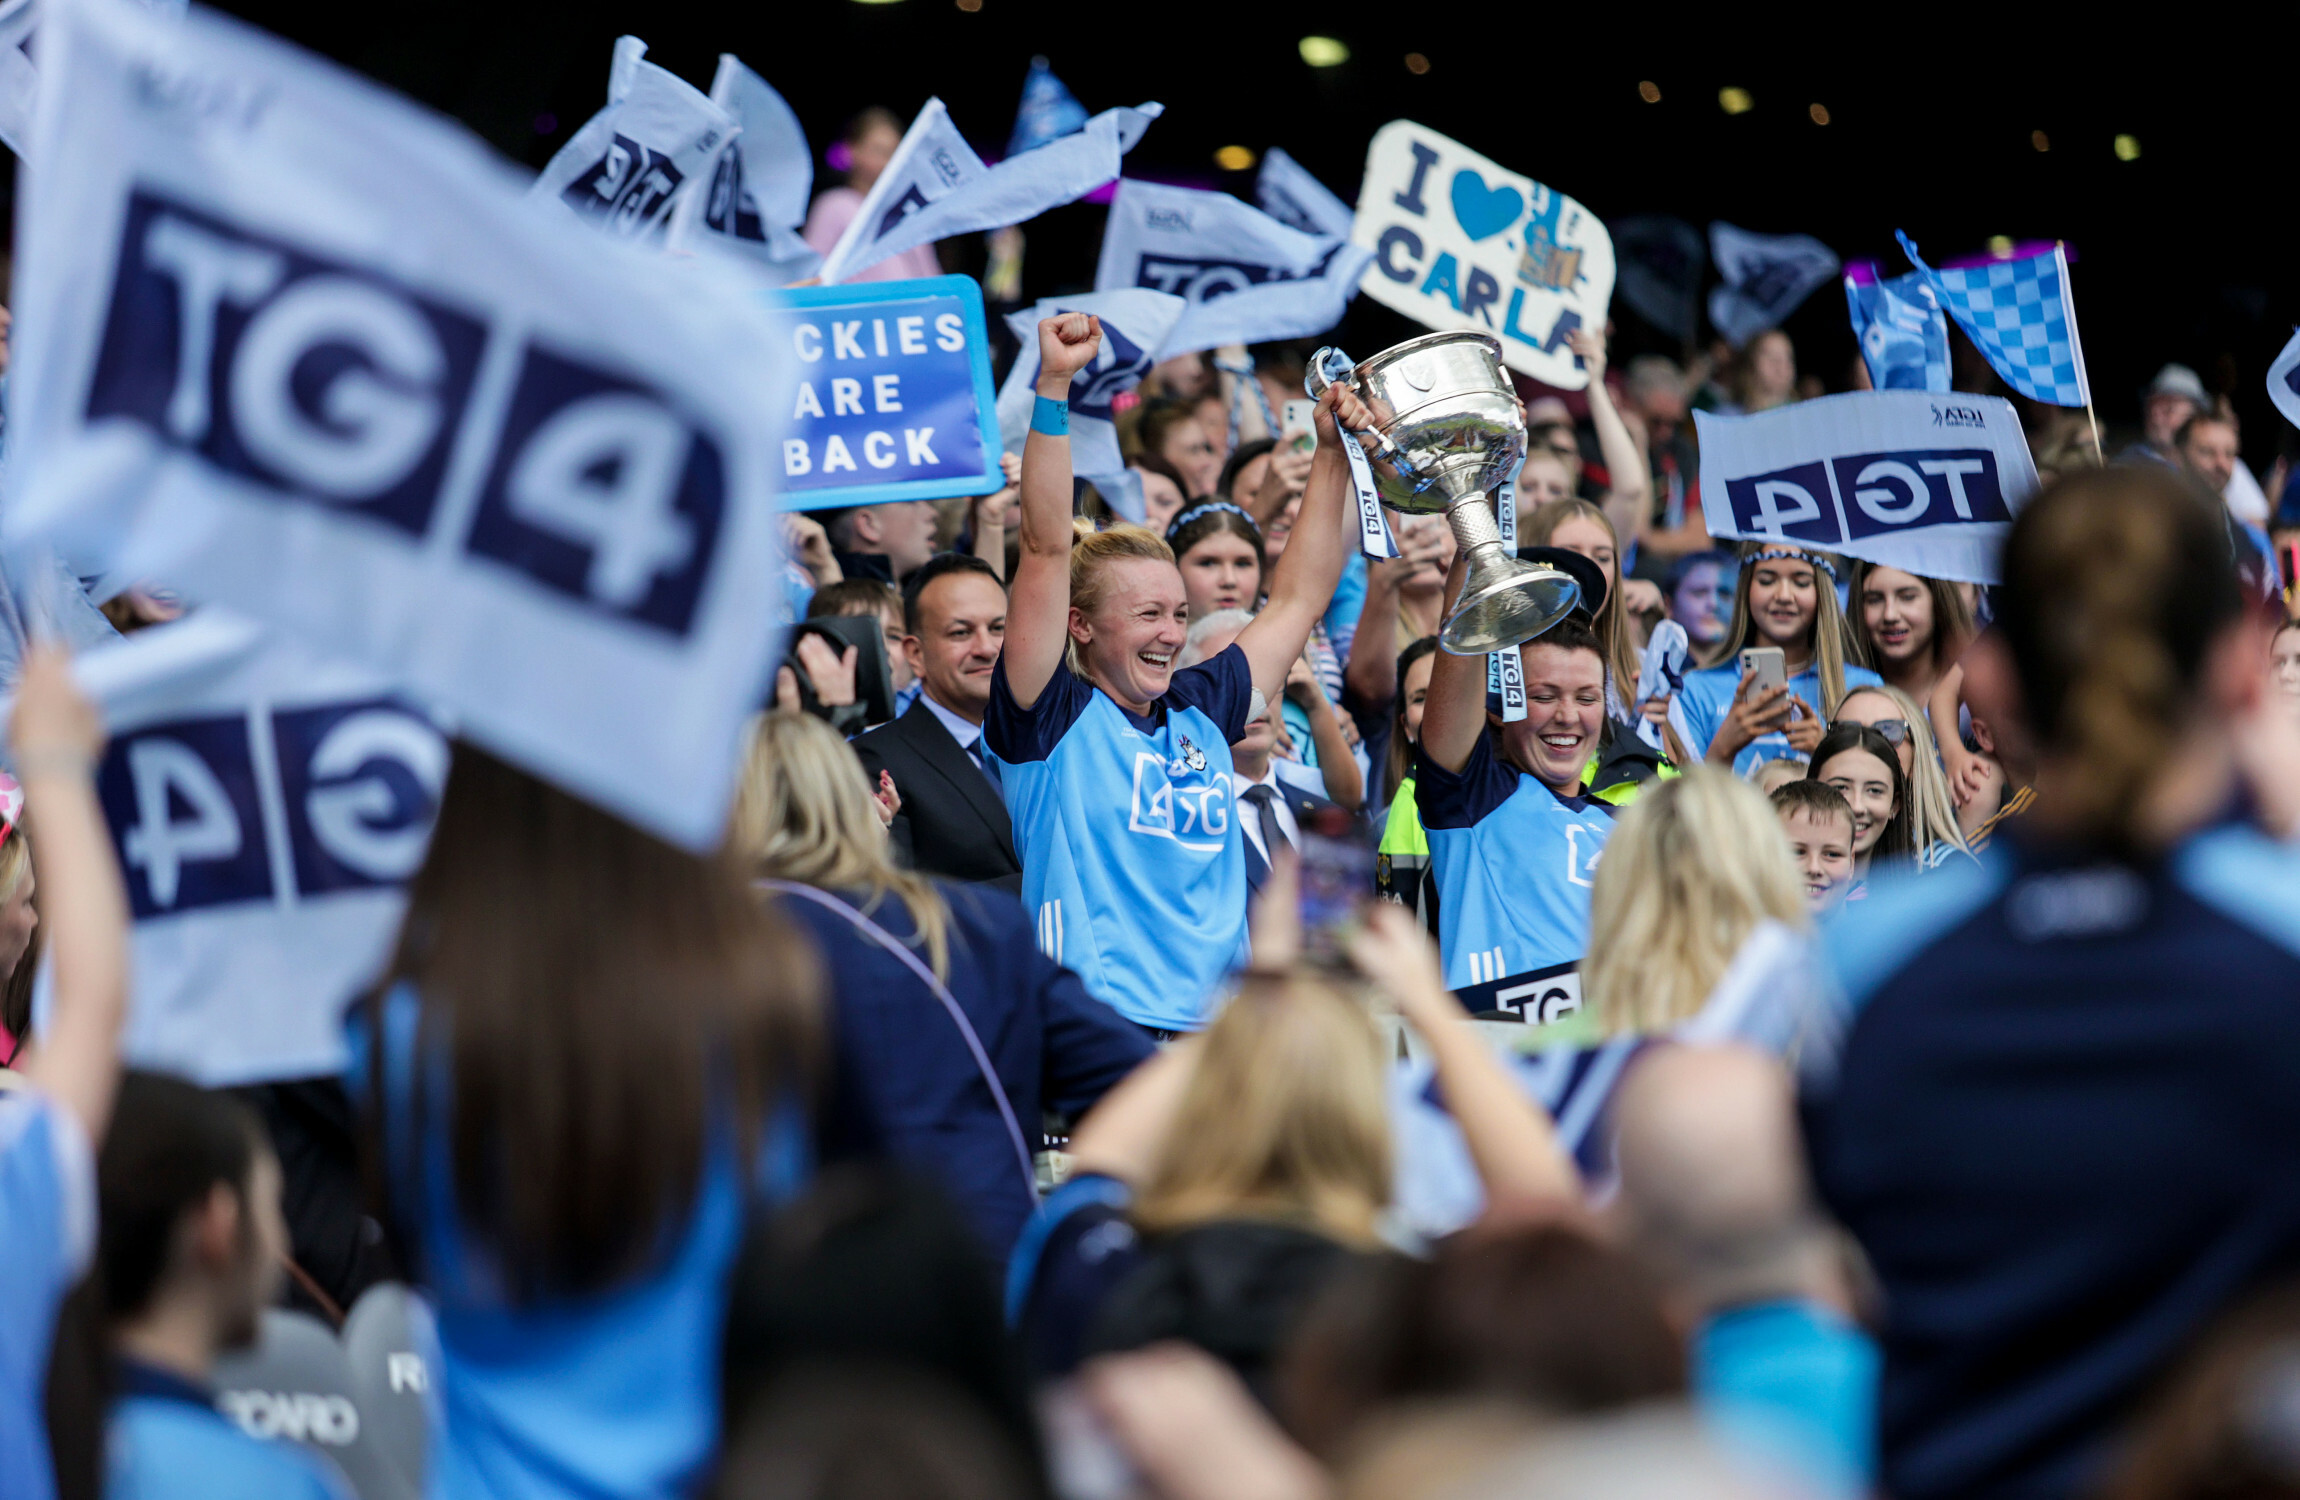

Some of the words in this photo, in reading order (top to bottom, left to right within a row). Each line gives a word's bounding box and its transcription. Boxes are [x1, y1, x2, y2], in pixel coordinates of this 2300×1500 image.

[1376, 226, 1585, 371] CARLA
[793, 313, 966, 362] CKIES
[142, 210, 697, 600] TG4
[793, 374, 904, 420] ARE
[783, 427, 941, 477] BACK
[1362, 491, 1381, 534] TG4
[1502, 495, 1513, 539] TG4
[1502, 654, 1522, 706] TG4
